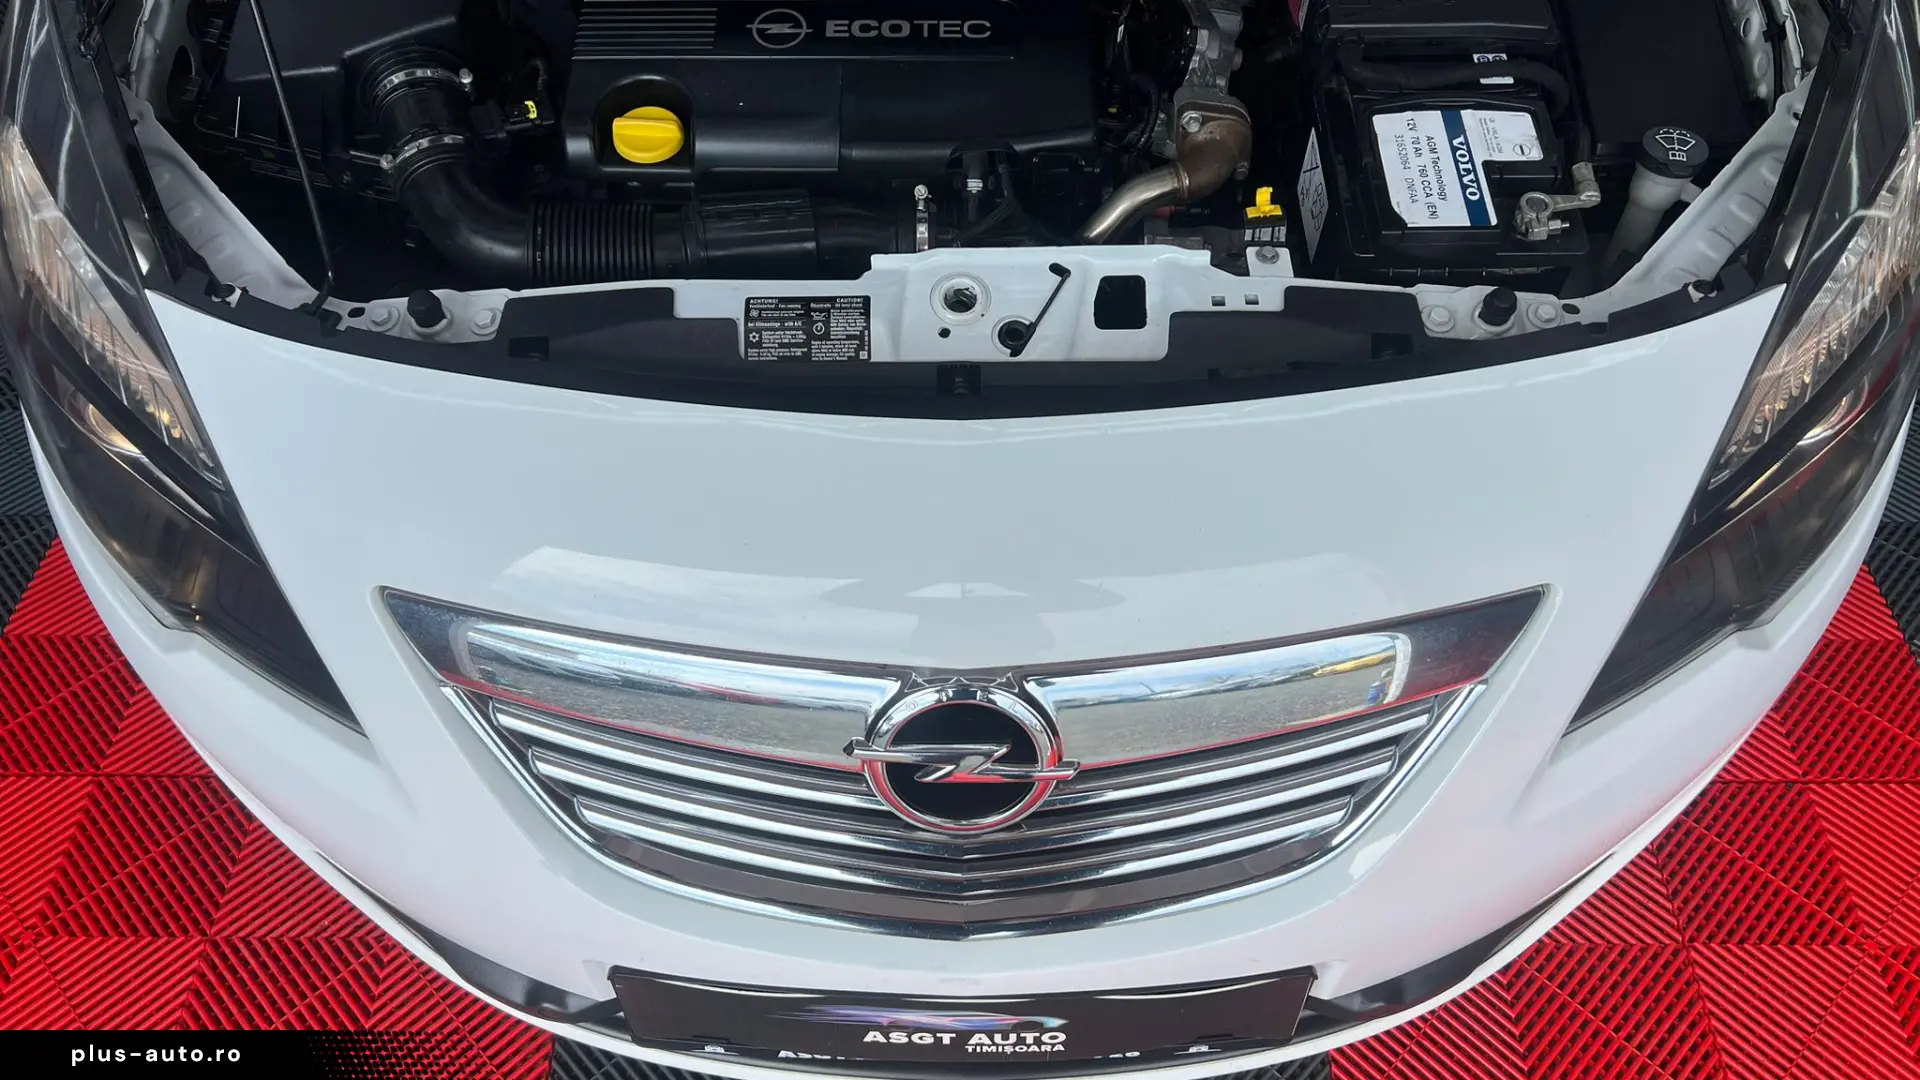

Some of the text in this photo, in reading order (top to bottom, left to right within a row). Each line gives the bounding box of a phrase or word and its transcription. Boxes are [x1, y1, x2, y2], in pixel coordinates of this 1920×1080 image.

[825, 19, 992, 38] ECOTEC
[1394, 134, 1419, 204] 31652064 DNFAA
[1407, 118, 1439, 220] 12V 70 Ah 760 CCA (EN)
[1425, 135, 1449, 202] AGM Technology
[1452, 134, 1480, 201] VOLVO
[863, 1030, 1067, 1045] ASGT AUTO
